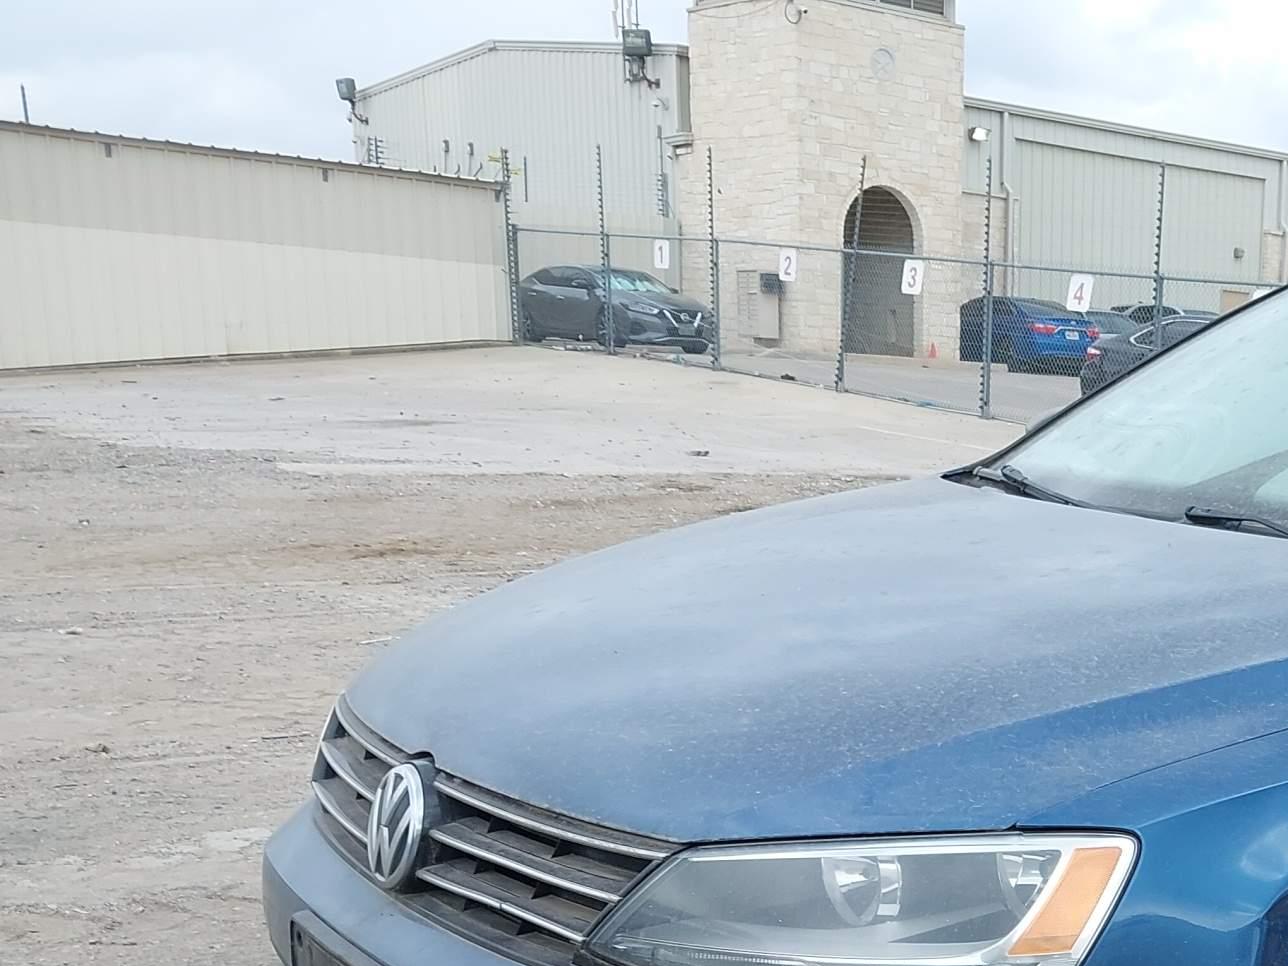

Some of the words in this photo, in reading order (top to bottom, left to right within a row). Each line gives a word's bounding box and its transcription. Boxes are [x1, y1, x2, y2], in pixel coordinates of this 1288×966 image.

[658, 245, 664, 264] 1
[784, 256, 792, 276] 2
[907, 267, 917, 288] 3
[1073, 282, 1084, 305] 4
